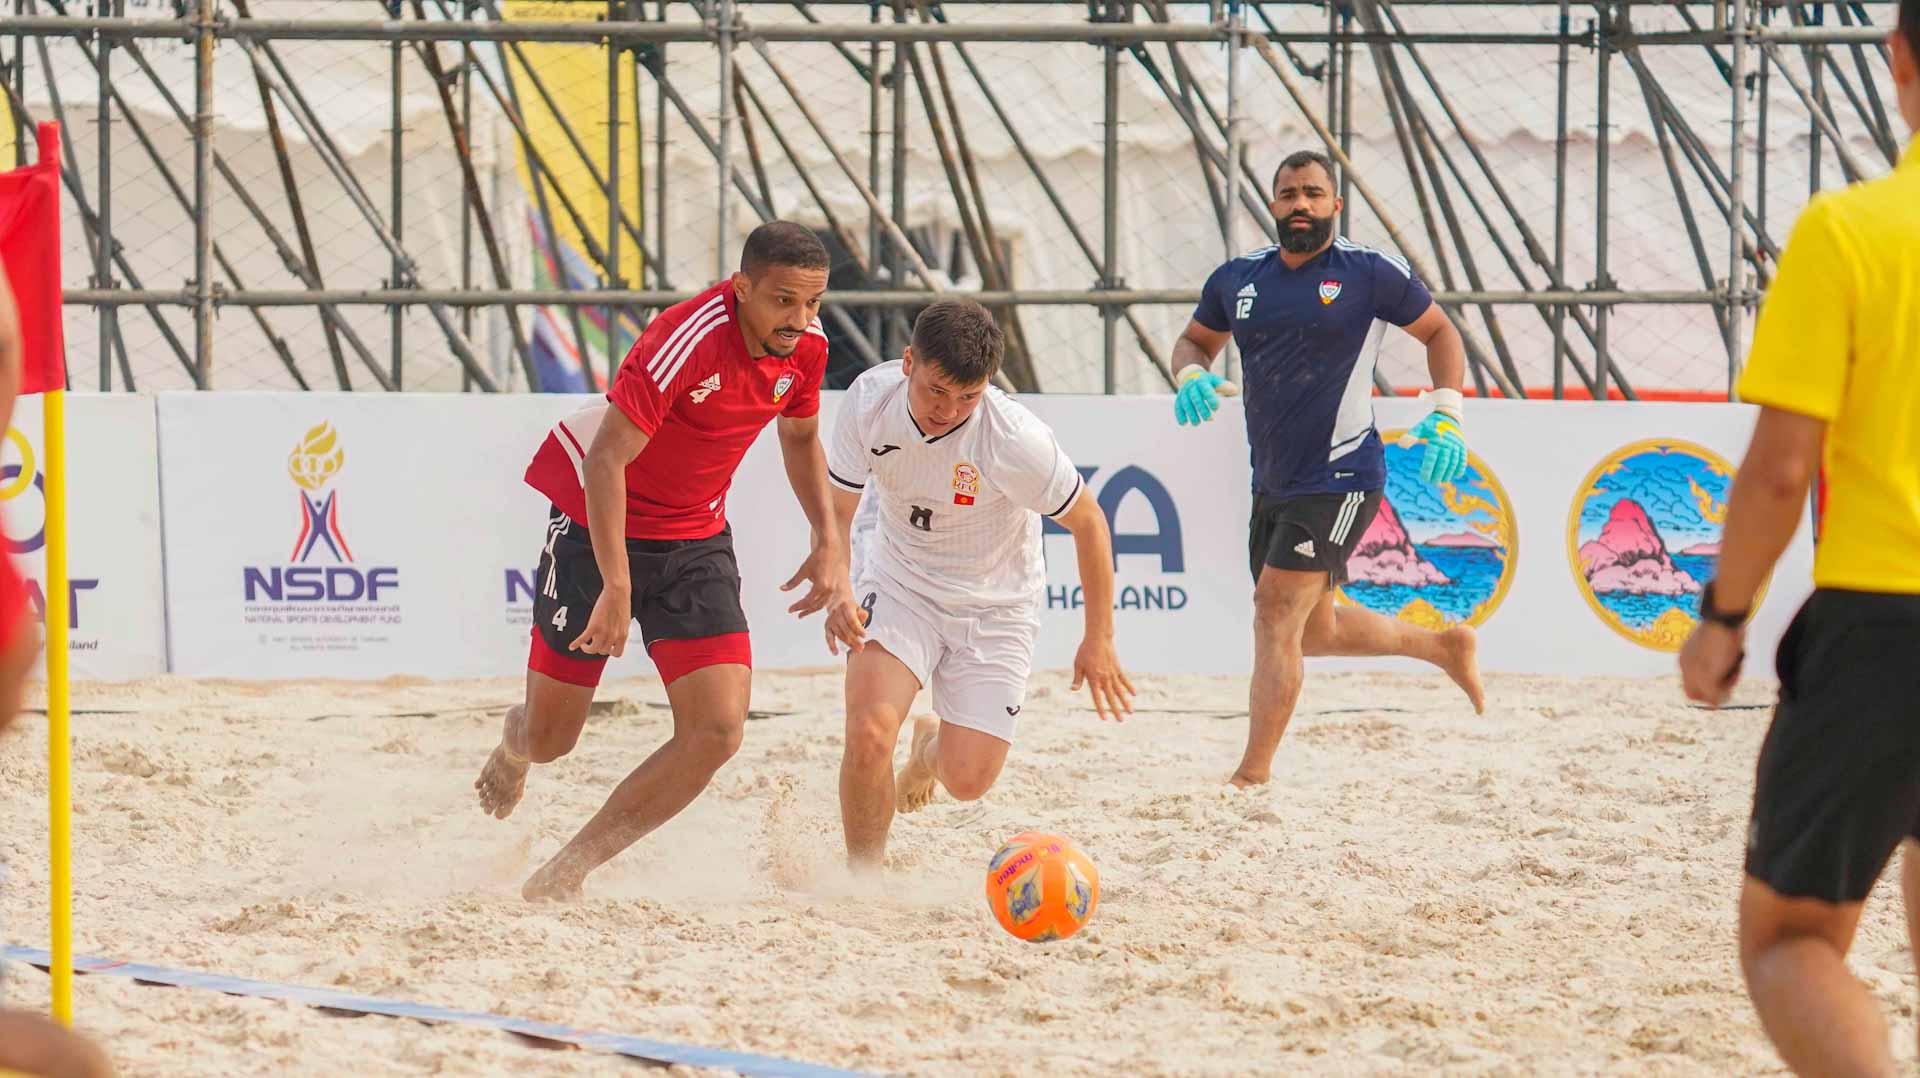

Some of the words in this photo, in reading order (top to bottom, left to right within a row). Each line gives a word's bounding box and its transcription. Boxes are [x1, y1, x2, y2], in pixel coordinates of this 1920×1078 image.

[1236, 298, 1253, 319] 12
[689, 388, 712, 404] 4
[244, 567, 399, 600] NSDF
[551, 605, 568, 631] 4
